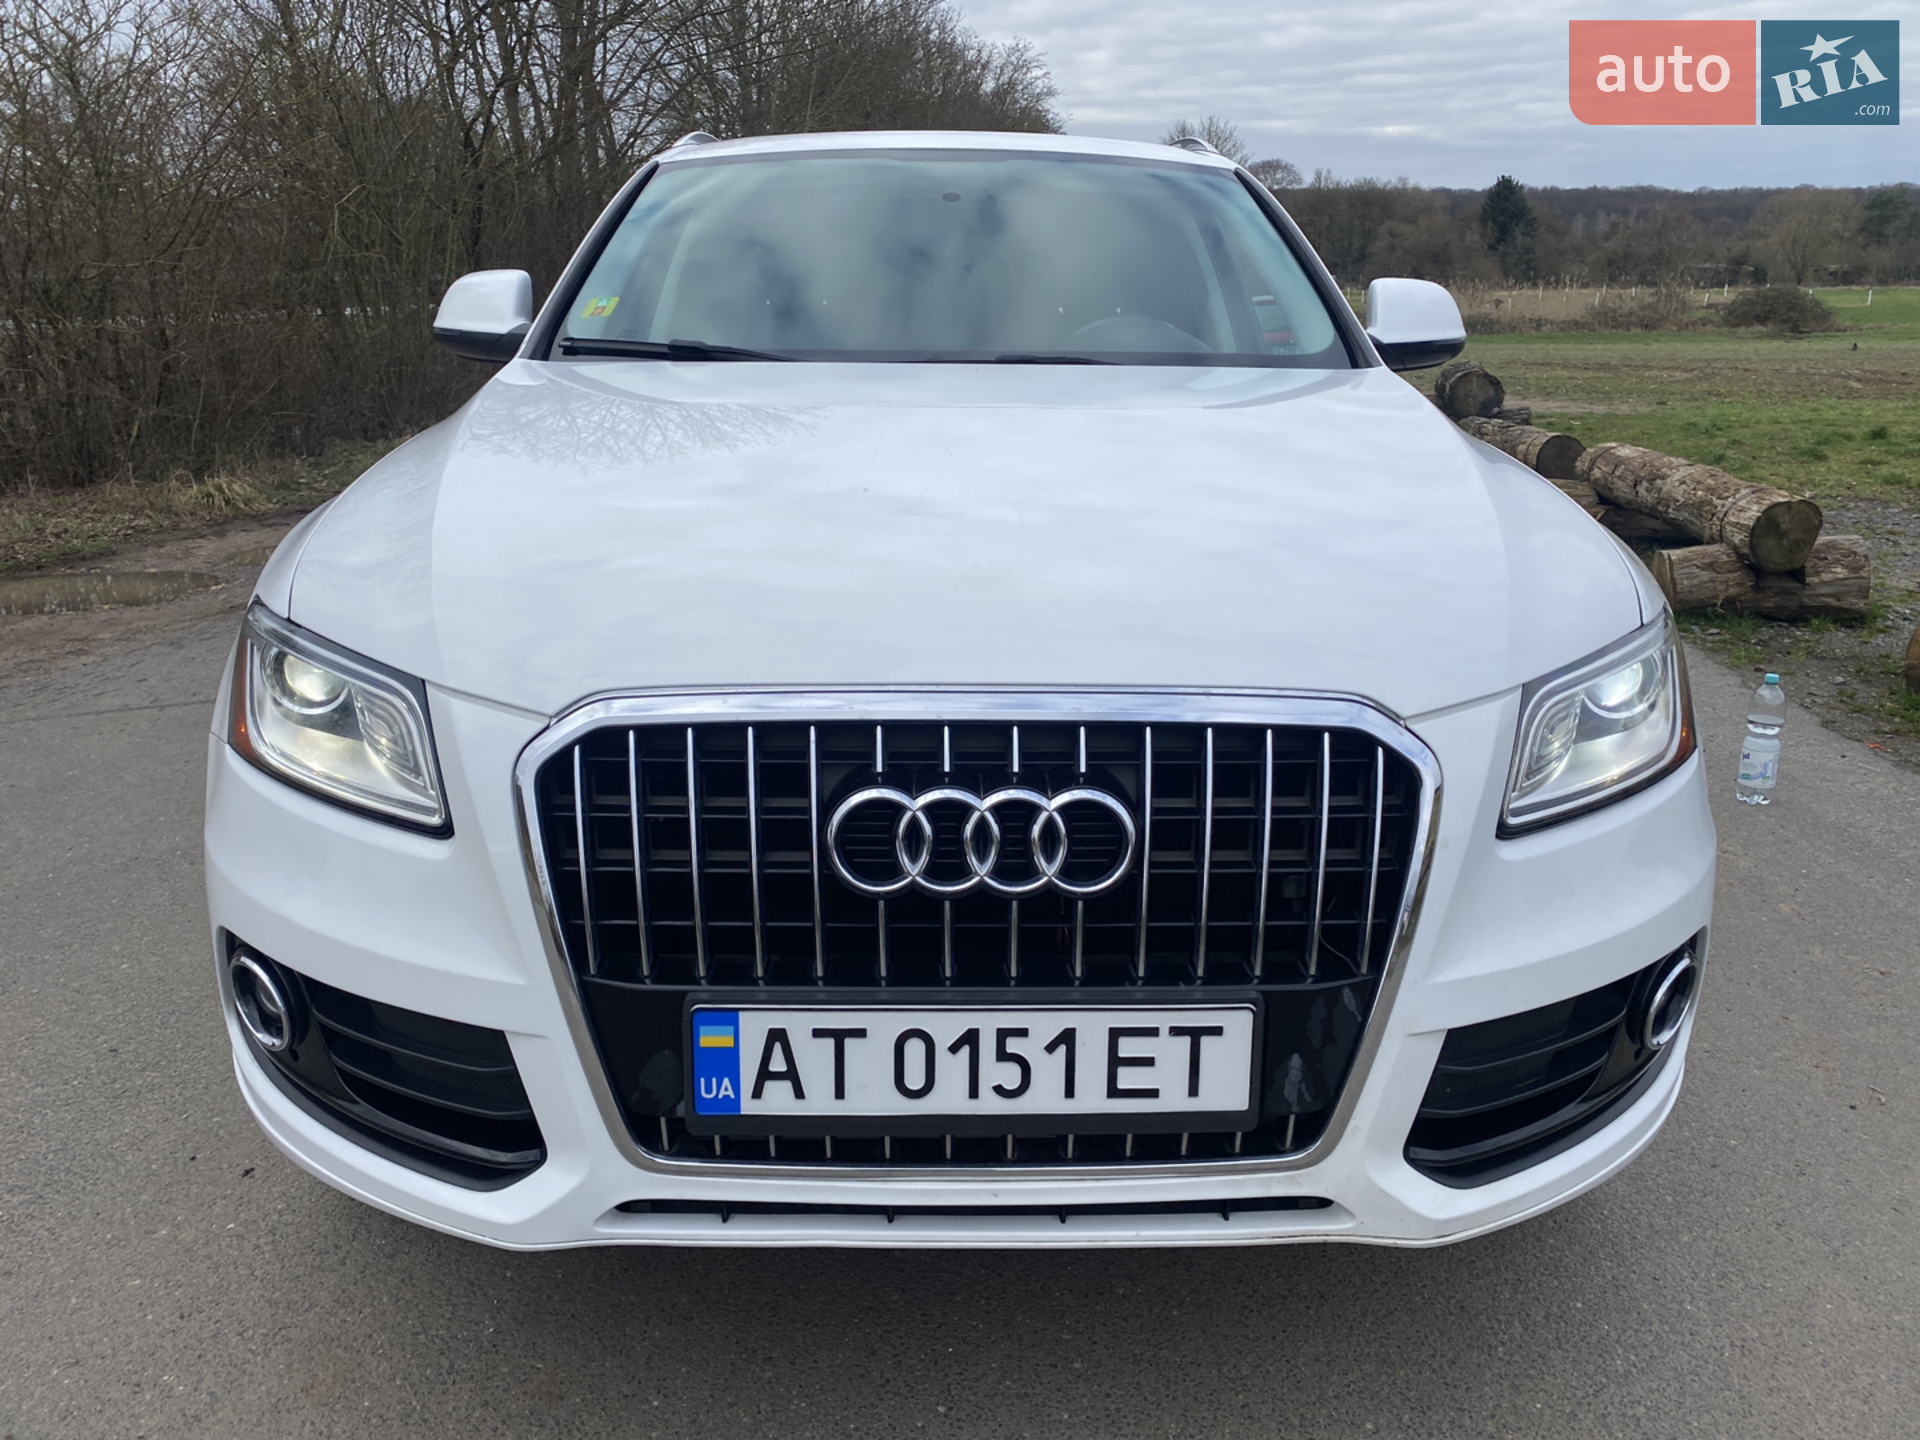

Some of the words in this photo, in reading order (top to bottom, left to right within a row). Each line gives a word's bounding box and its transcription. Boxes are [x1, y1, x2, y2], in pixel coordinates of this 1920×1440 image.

[751, 1027, 867, 1100] AT
[893, 1027, 1077, 1099] 0151
[1106, 1025, 1224, 1099] ET
[700, 1078, 735, 1099] UA
